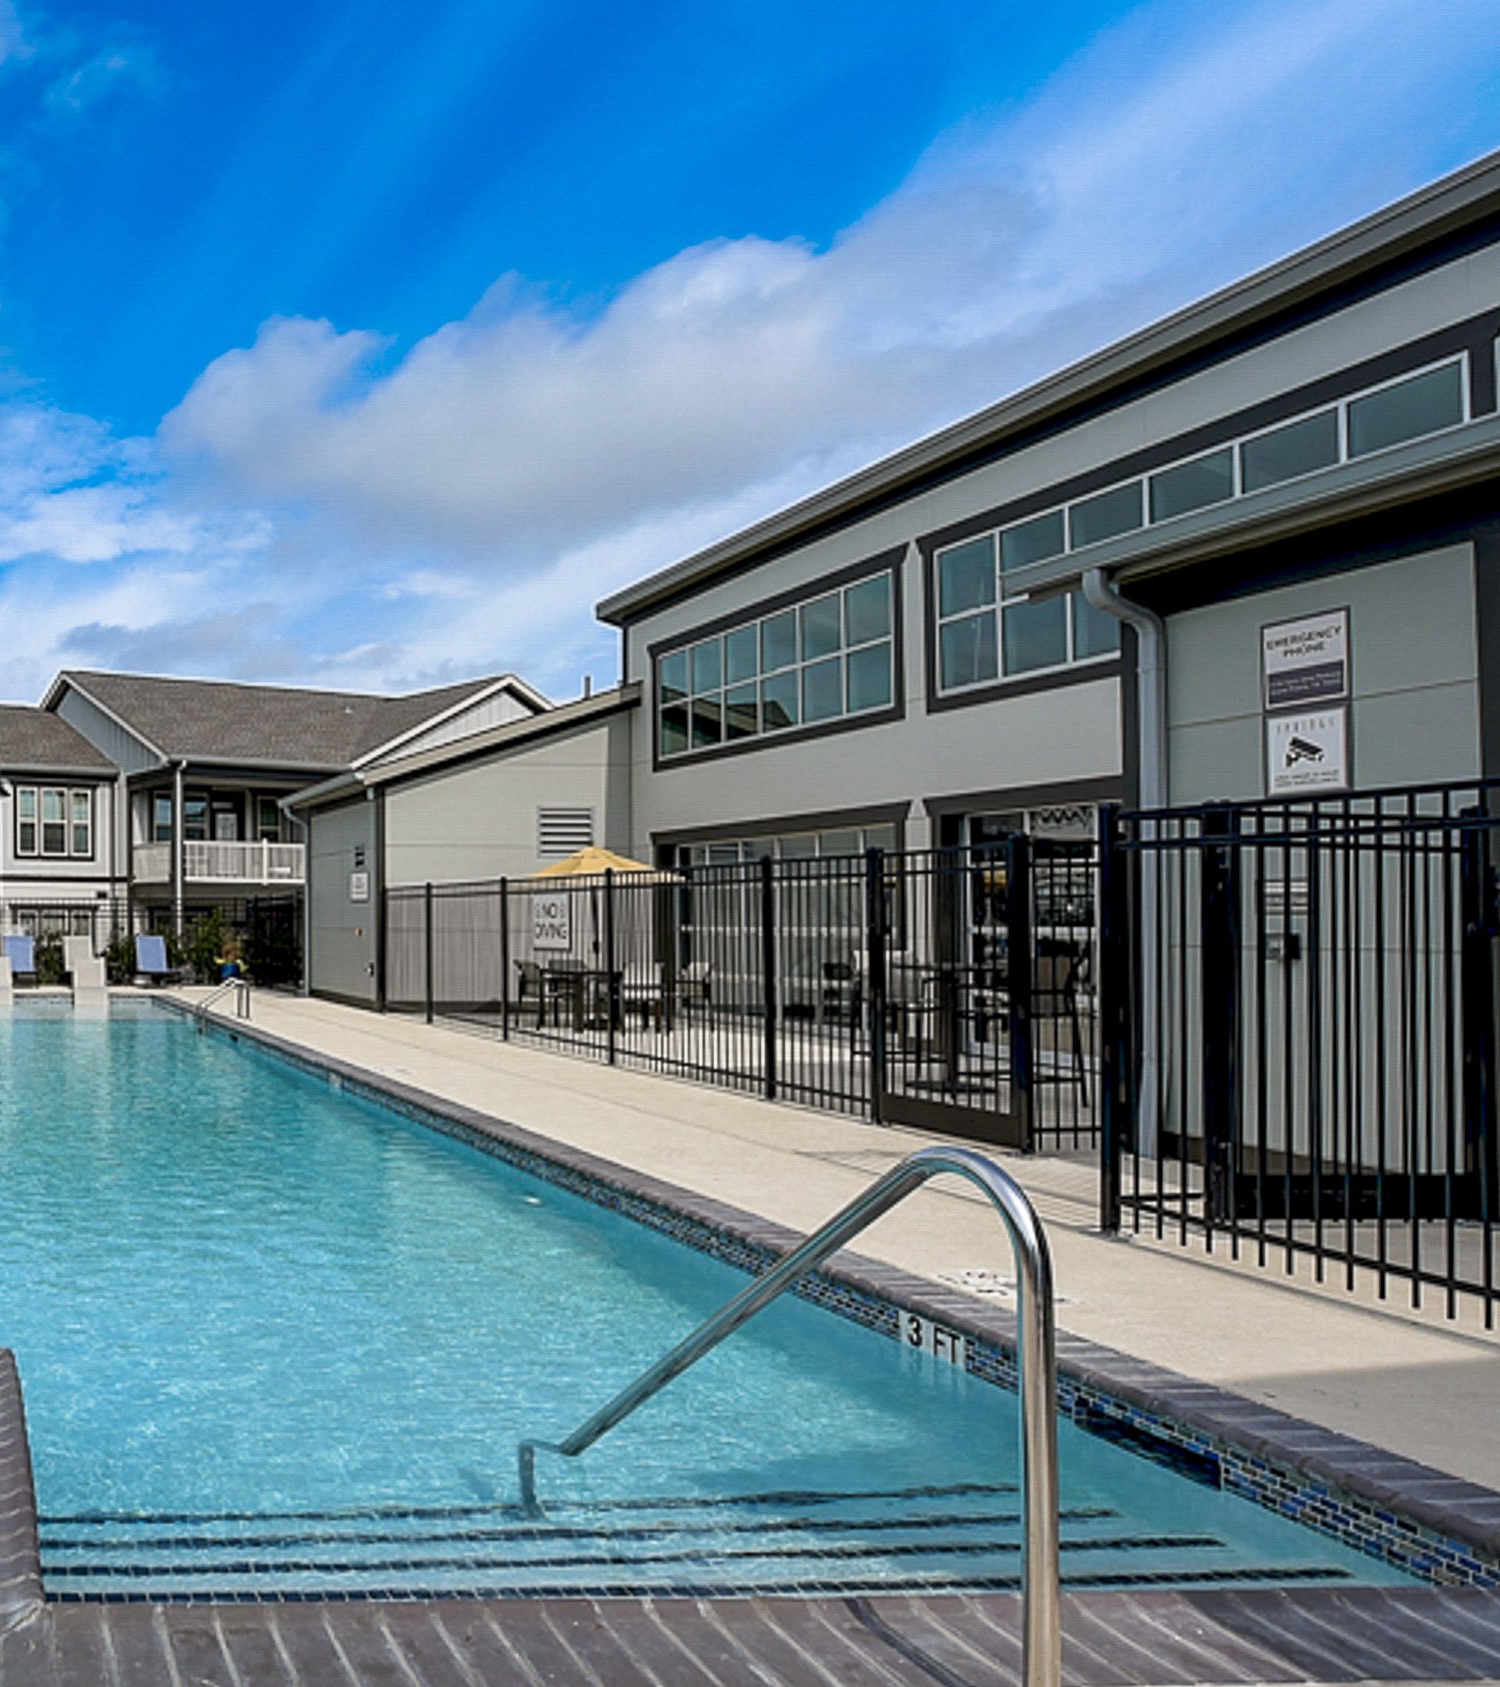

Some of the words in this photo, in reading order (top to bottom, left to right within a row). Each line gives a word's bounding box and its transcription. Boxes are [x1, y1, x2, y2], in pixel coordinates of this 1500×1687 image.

[1267, 626, 1341, 650] EMERGENCY
[1284, 642, 1324, 657] PHONE
[543, 903, 557, 918] NO
[536, 922, 567, 939] DIVING
[908, 1316, 922, 1347] 3
[934, 1325, 960, 1363] FT
